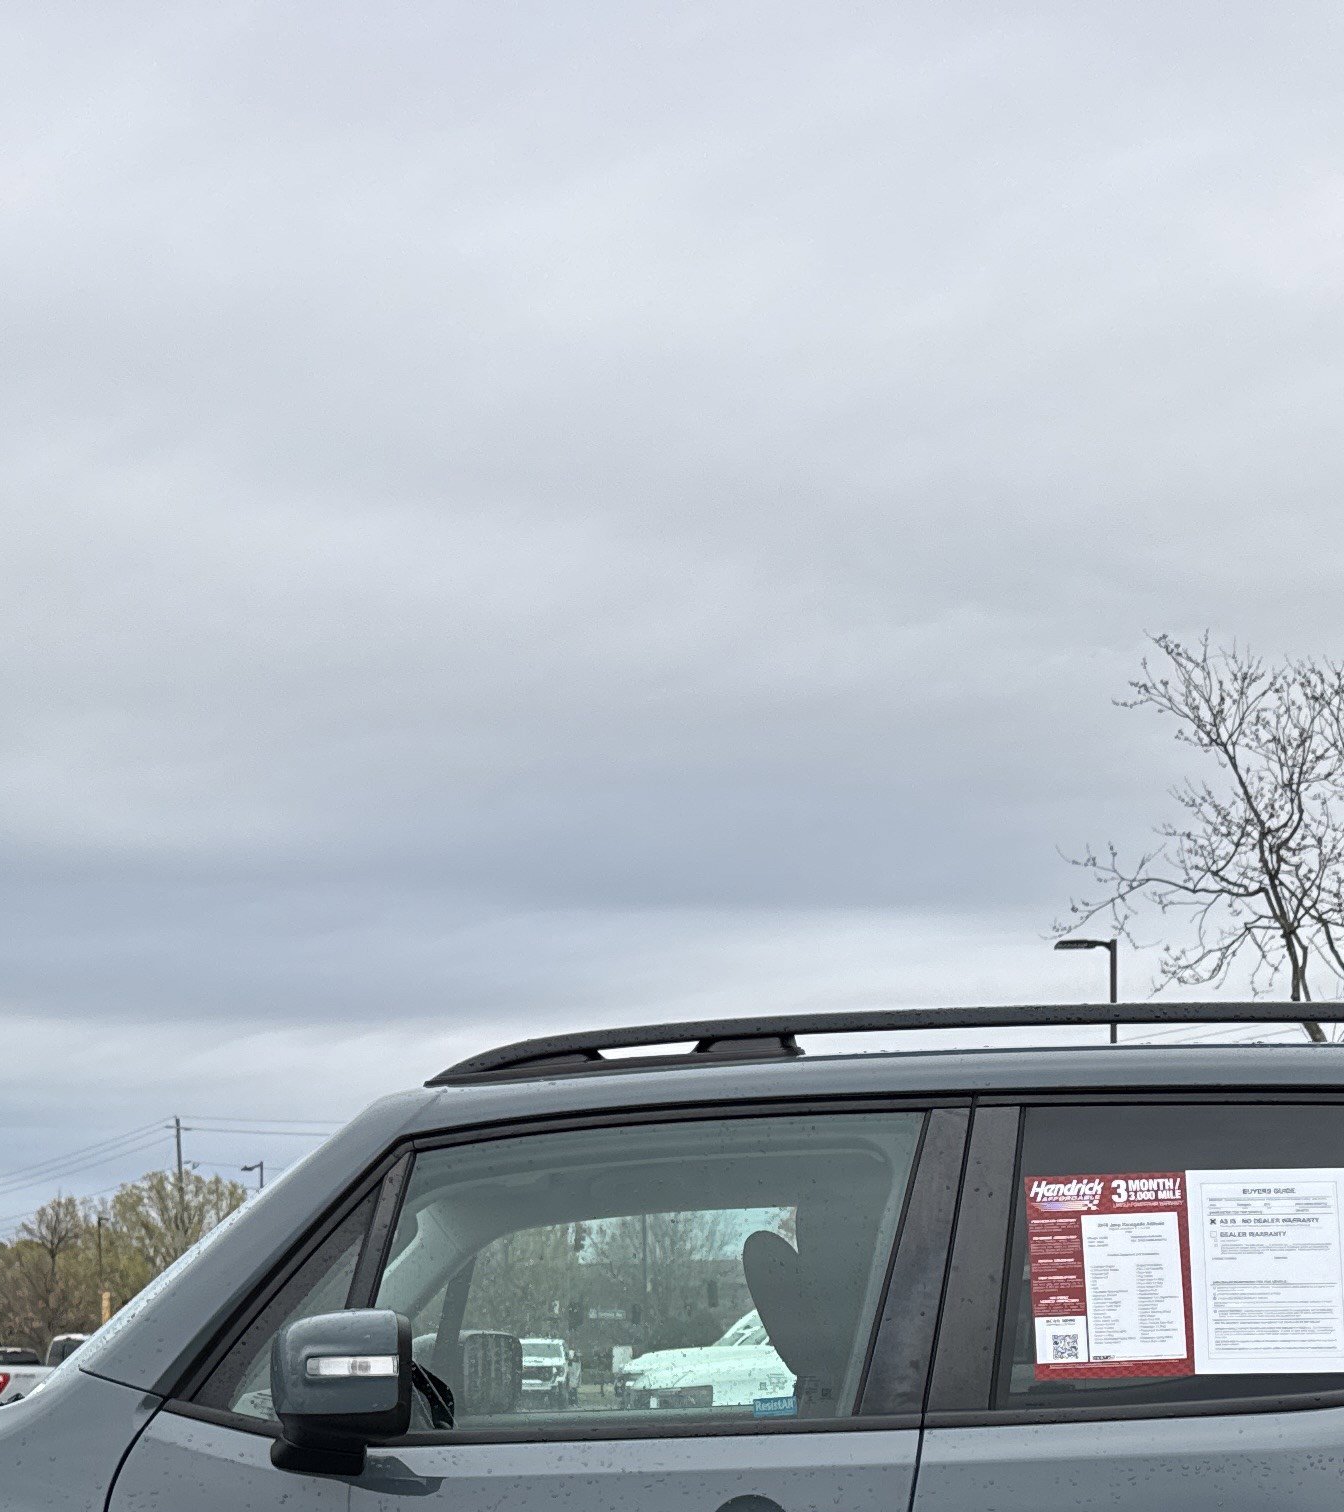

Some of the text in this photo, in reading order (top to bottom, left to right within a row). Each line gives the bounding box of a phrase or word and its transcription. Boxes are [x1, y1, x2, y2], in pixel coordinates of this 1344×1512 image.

[1030, 1179, 1104, 1202] Hendrick
[1111, 1178, 1181, 1202] 3 MONTH/
[1128, 1190, 1182, 1201] 3,000 MILE
